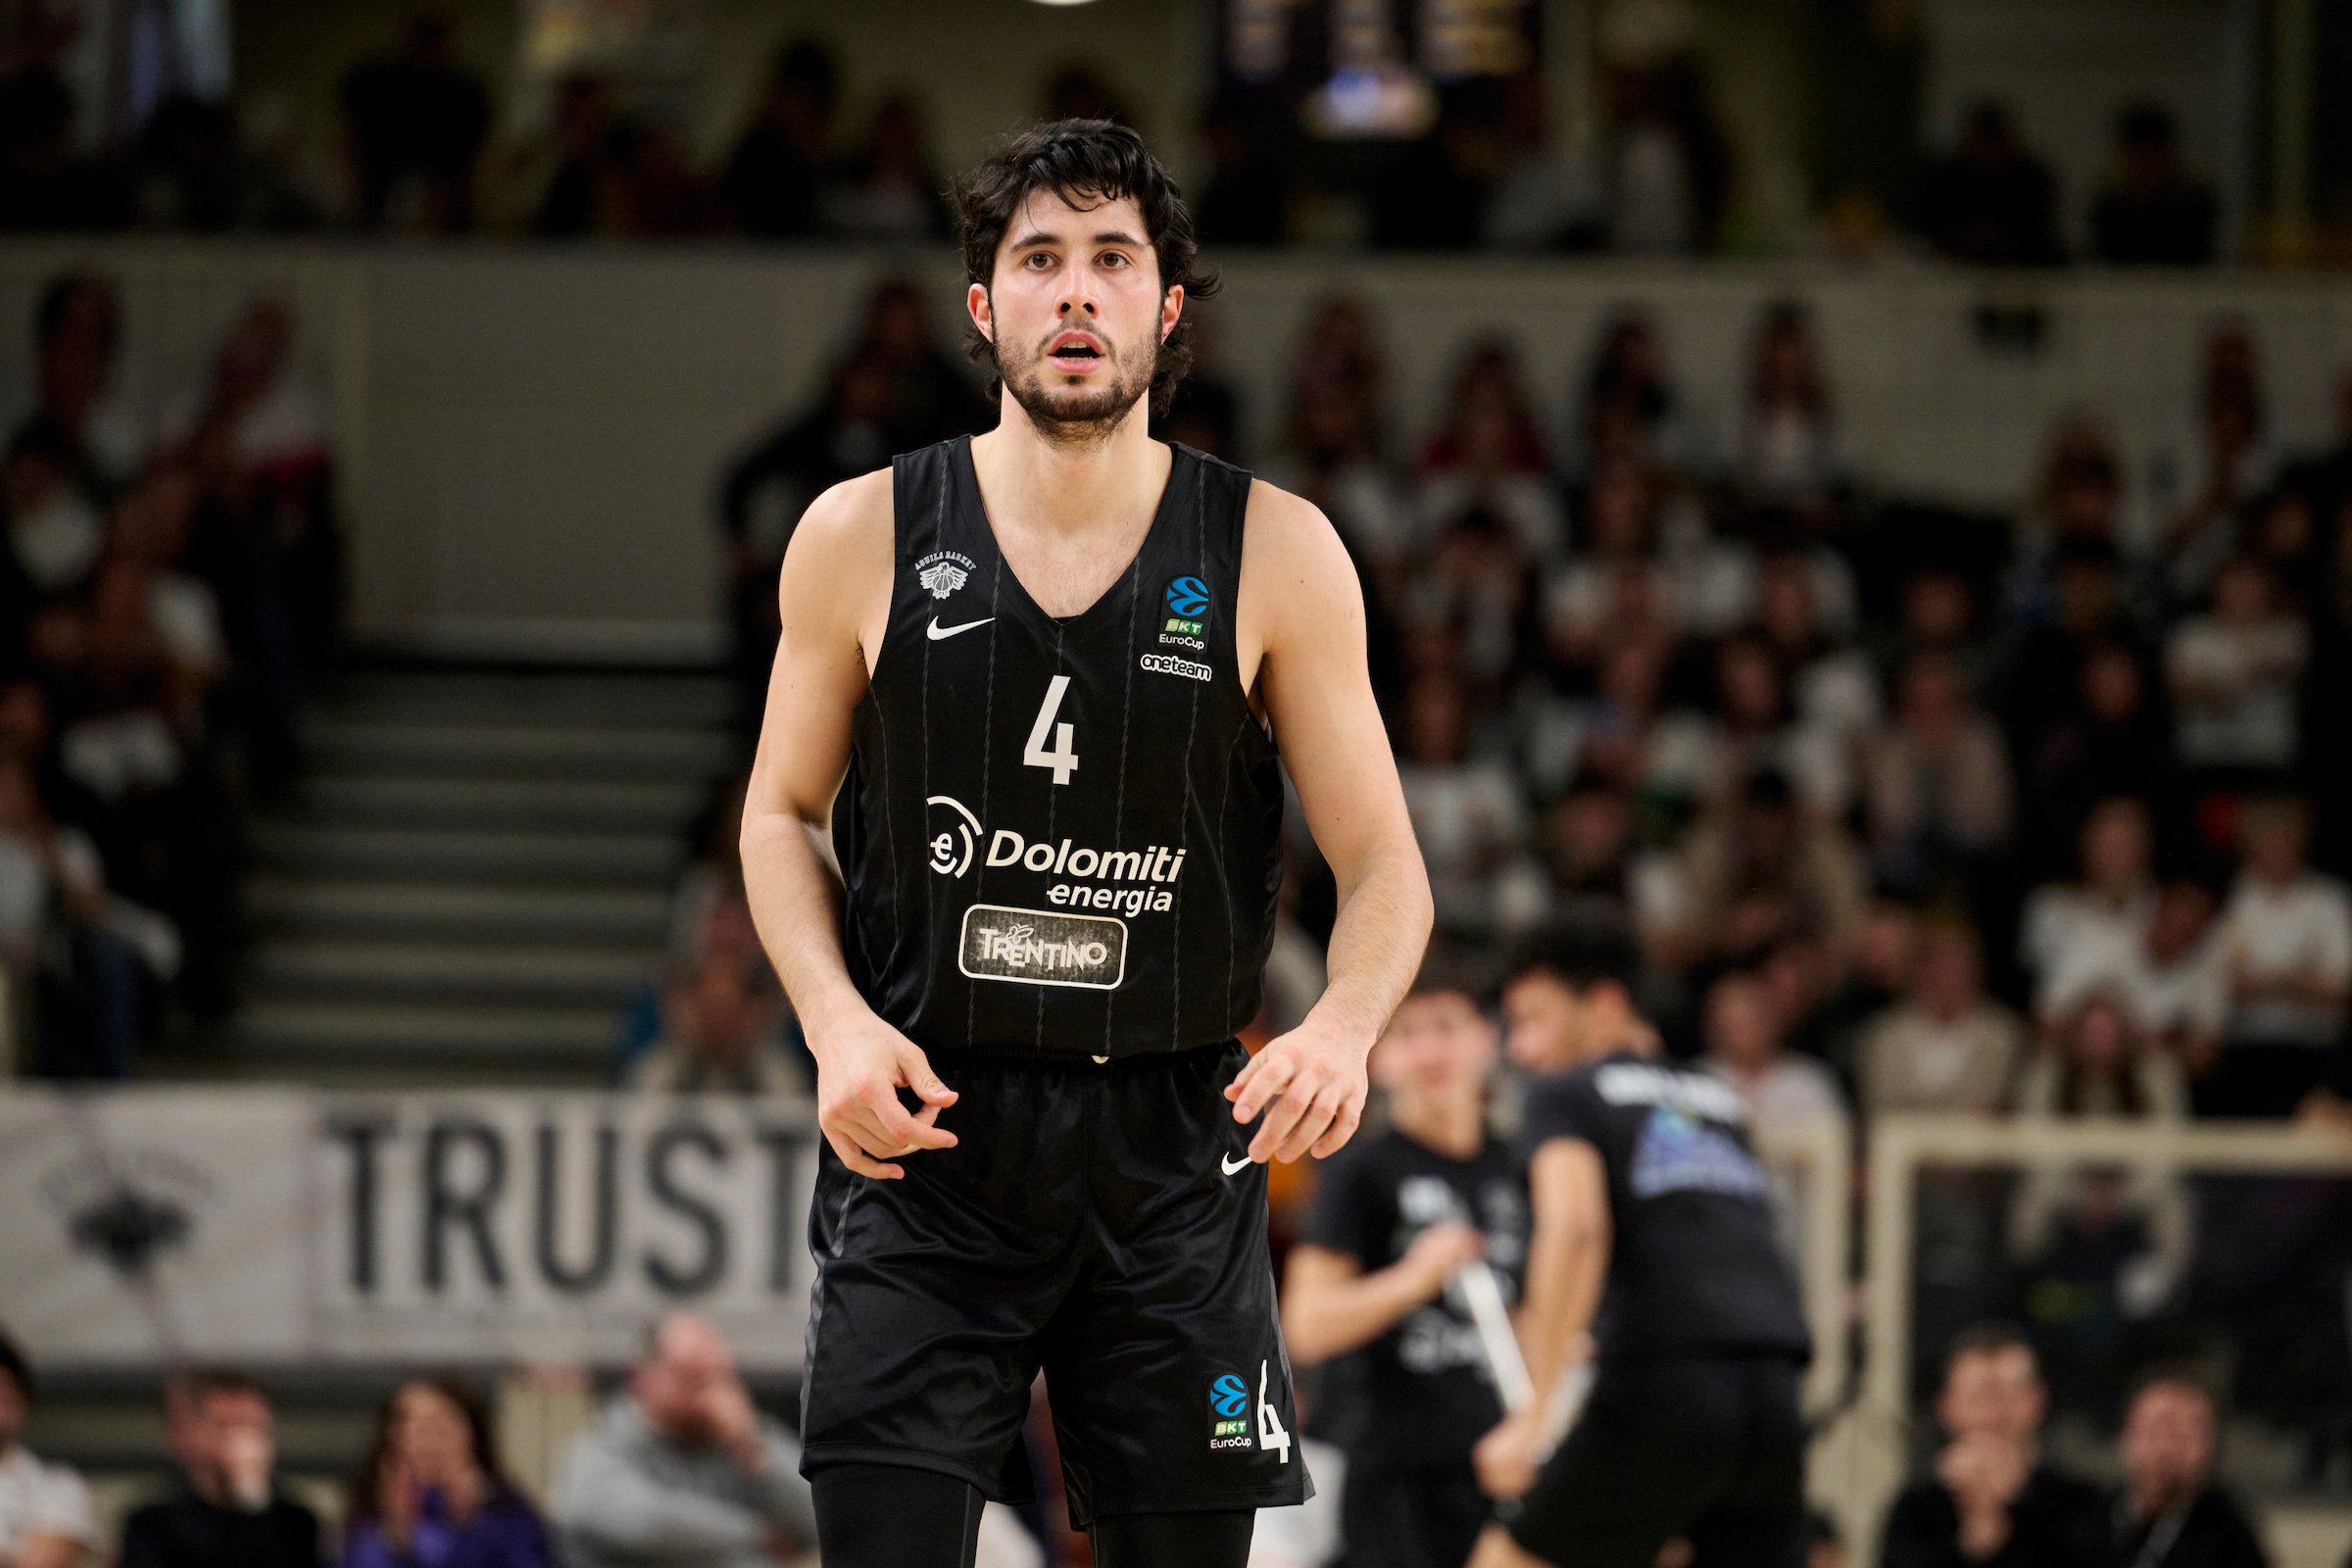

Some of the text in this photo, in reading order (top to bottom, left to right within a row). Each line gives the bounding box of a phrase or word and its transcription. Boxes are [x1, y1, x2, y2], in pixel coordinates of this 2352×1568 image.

[913, 550, 977, 571] AQUILA BASKET
[1166, 619, 1201, 634] BKT
[1158, 633, 1204, 651] EuroCup
[1142, 655, 1211, 681] oneteam
[1023, 674, 1078, 785] 4
[986, 829, 1187, 883] Dolomiti
[1047, 883, 1173, 917] energia
[979, 927, 1108, 971] TRENTINO
[326, 1120, 818, 1298] TRUST
[1256, 1358, 1291, 1464] 4
[1210, 1436, 1252, 1449] EuroCup
[1216, 1422, 1247, 1435] BKT
